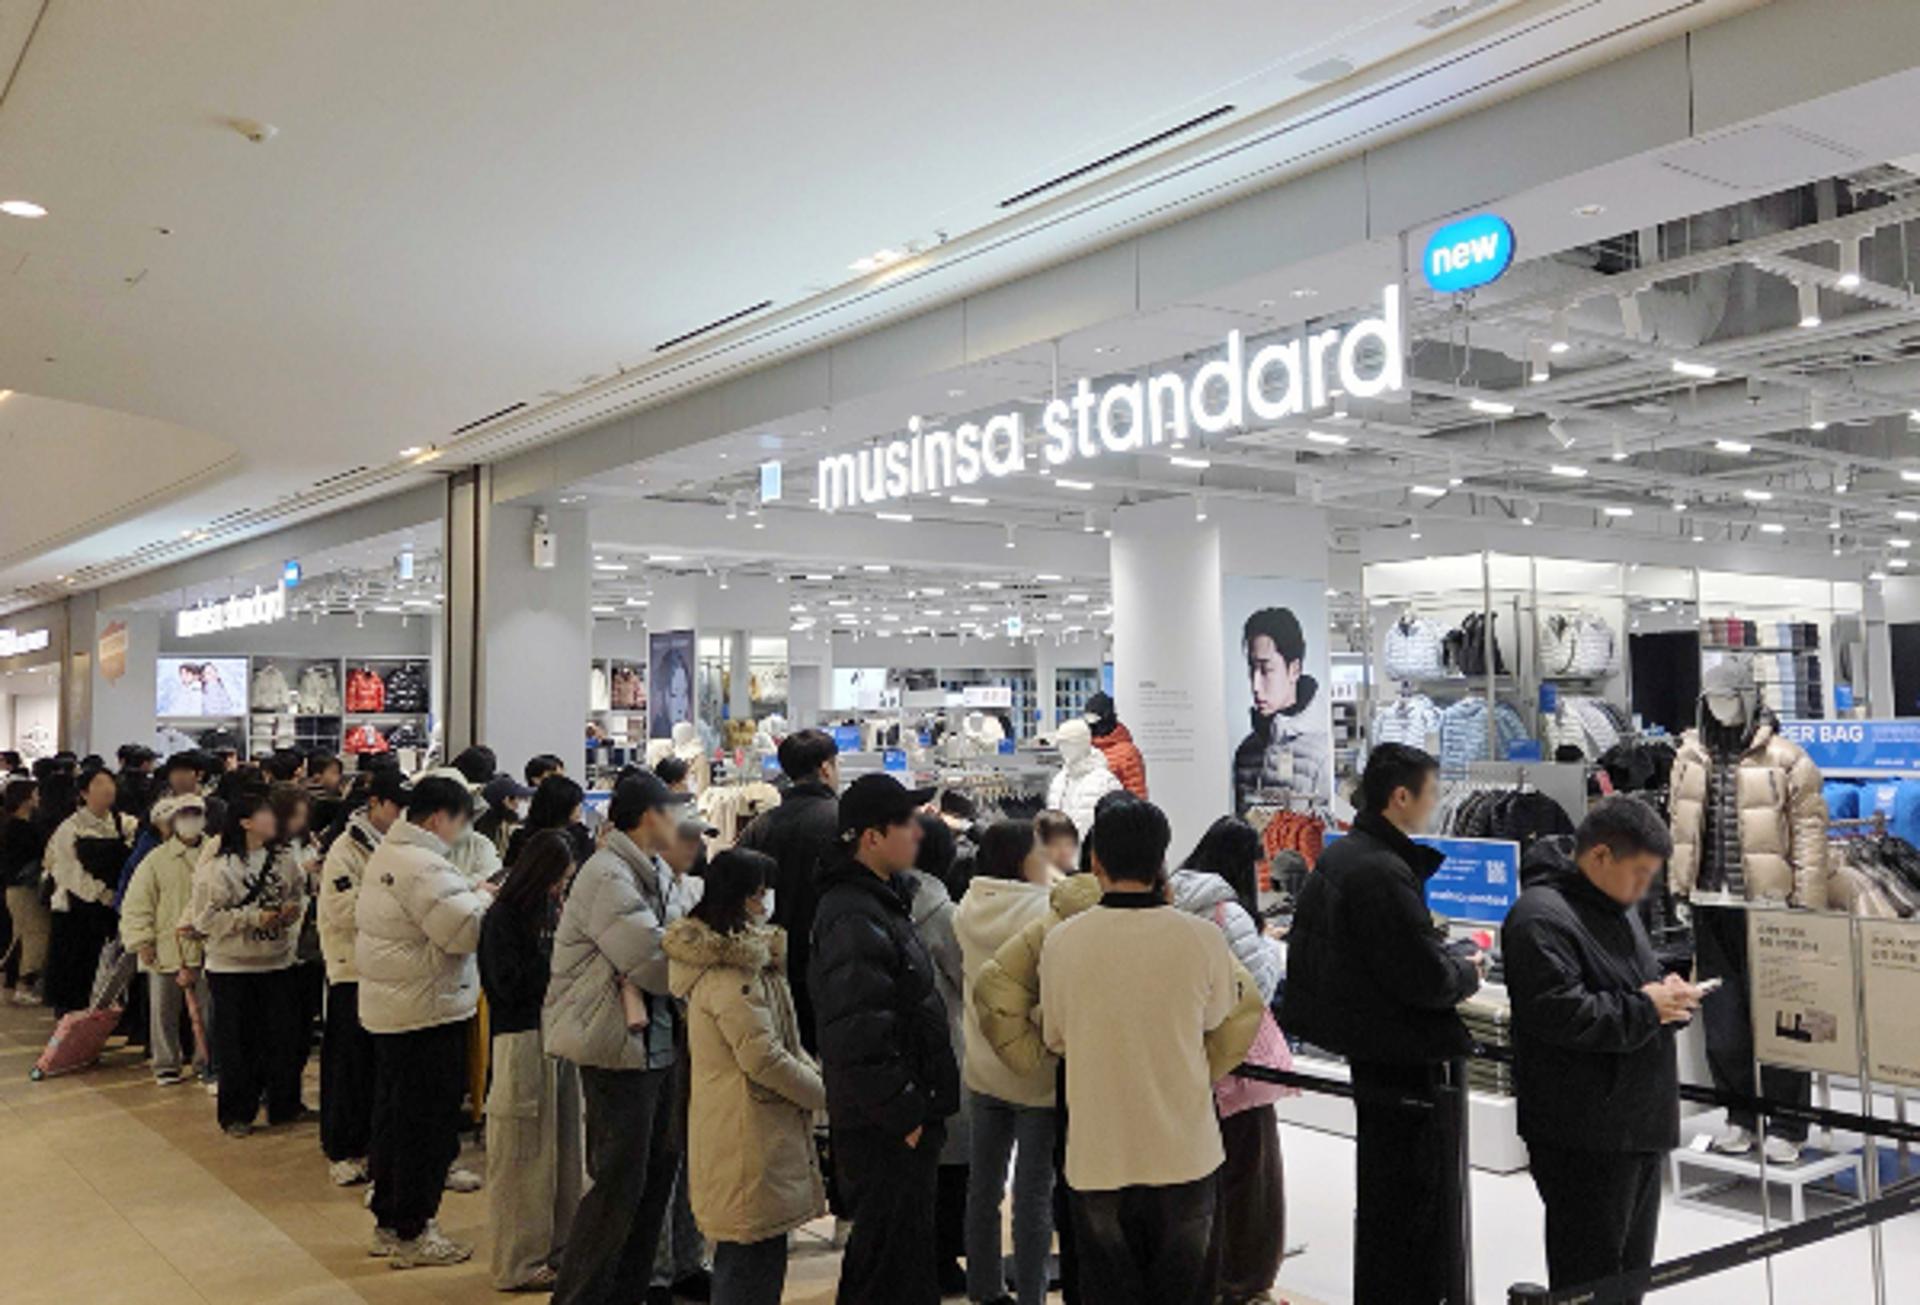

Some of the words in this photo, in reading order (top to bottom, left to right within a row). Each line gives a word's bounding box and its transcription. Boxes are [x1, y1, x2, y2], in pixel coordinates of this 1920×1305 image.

[1432, 231, 1499, 276] new
[817, 412, 1025, 512] musinsa
[1042, 284, 1403, 465] standard
[1820, 725, 1864, 743] BAG
